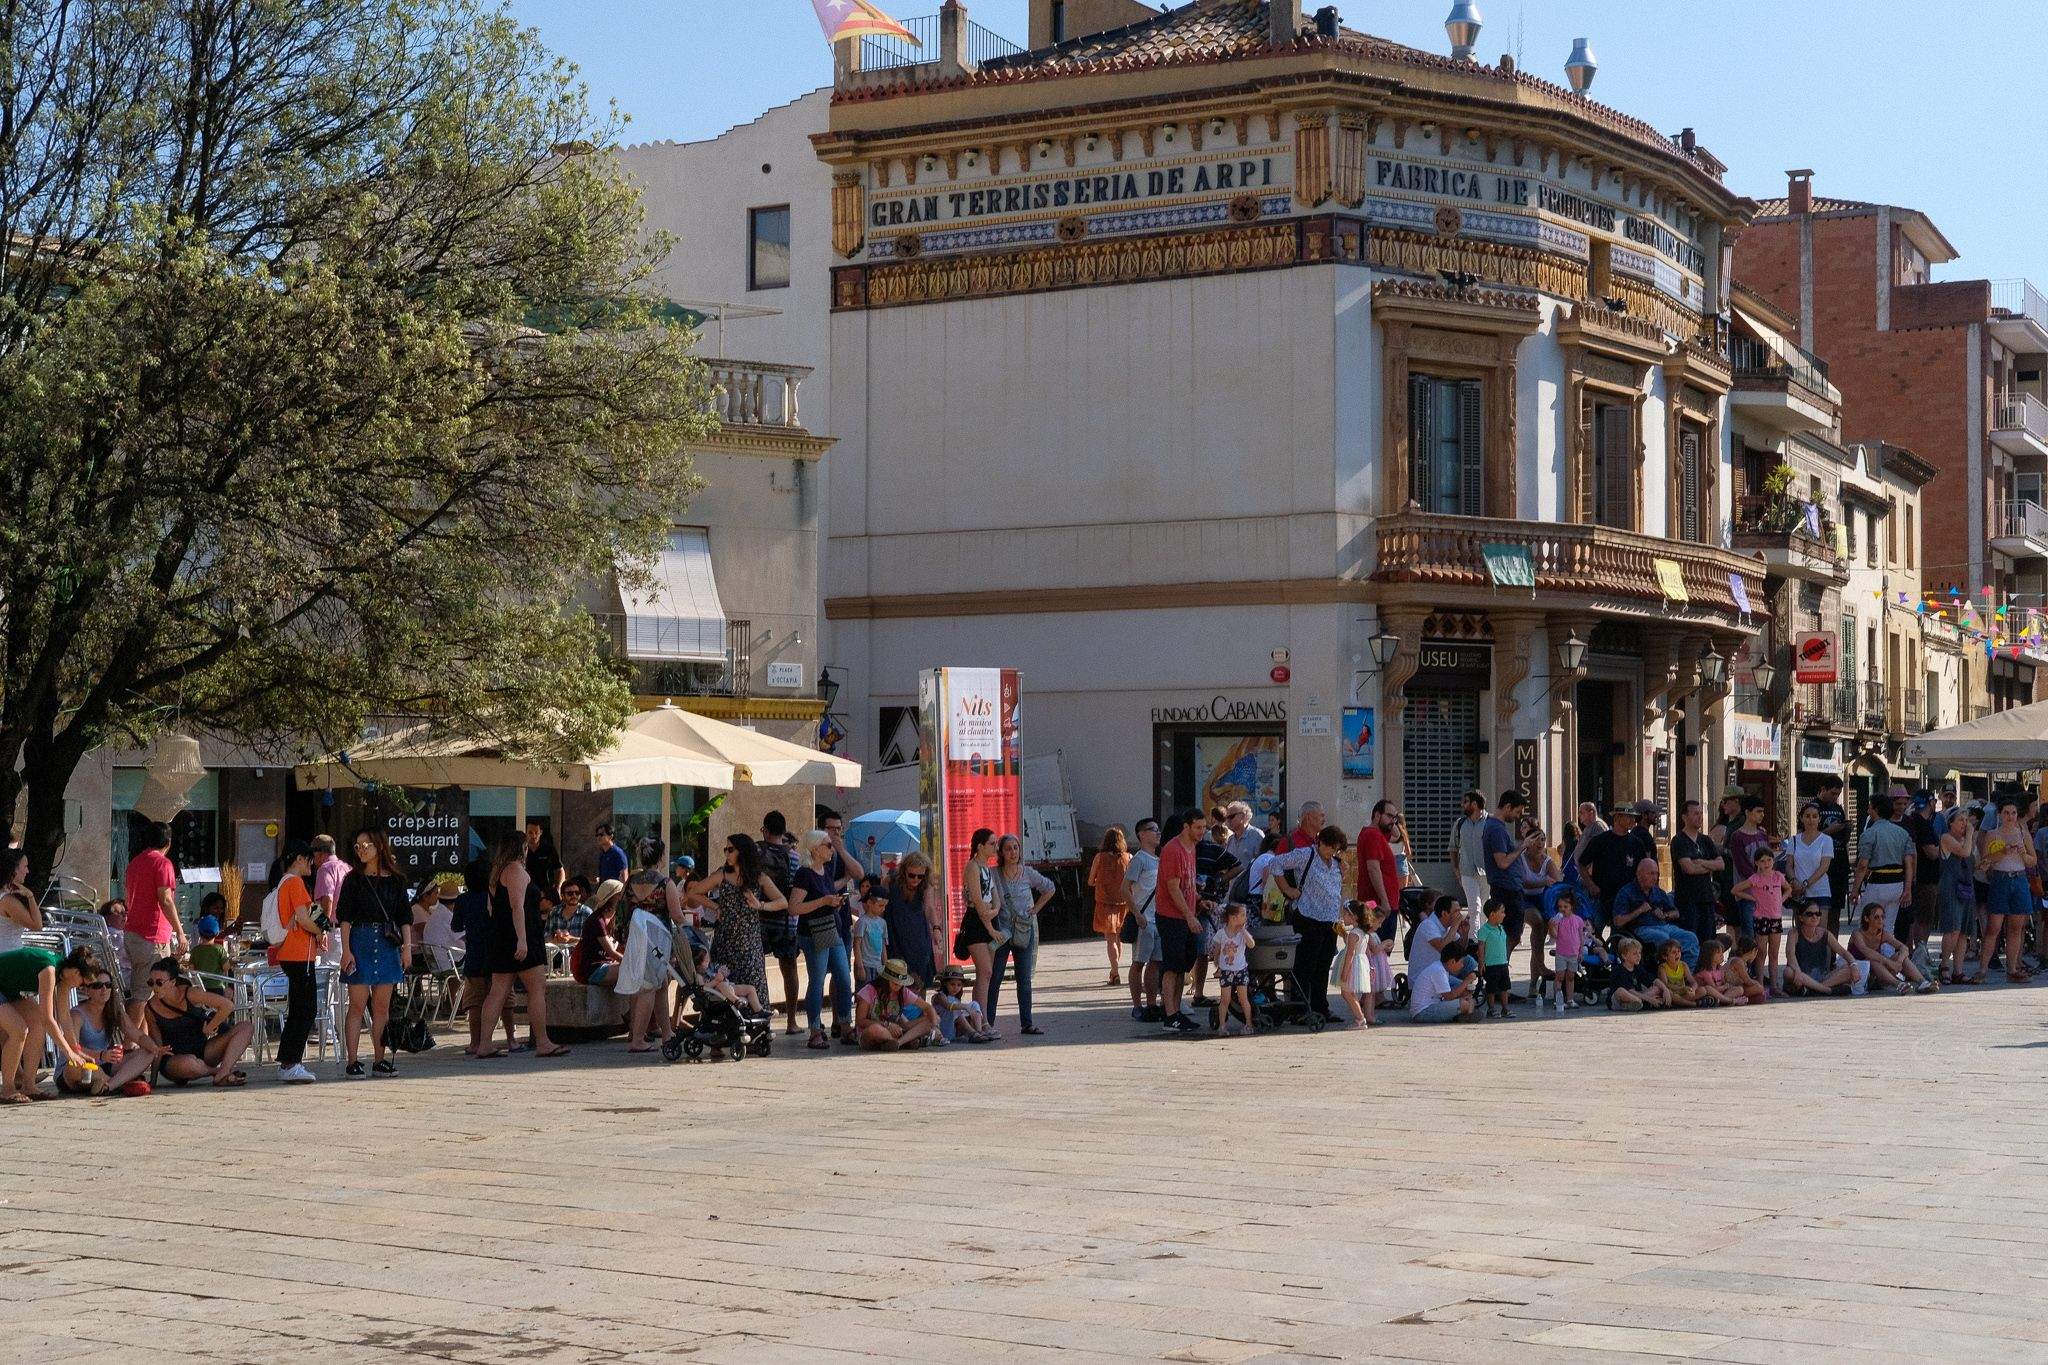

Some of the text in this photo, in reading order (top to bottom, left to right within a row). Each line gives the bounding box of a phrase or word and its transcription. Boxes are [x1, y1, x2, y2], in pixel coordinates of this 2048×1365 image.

[871, 158, 1272, 227] GRAN TERRISSERIA DE ARPI
[1377, 160, 1483, 199] FABRICA
[1497, 178, 1529, 206] DE
[1420, 650, 1458, 668] USEU
[956, 694, 992, 717] Nits
[1151, 695, 1287, 722] FUNDACIÓ CABANAS
[1517, 744, 1535, 819] MUSE
[388, 814, 459, 831] creperia
[388, 832, 460, 847] restaurant
